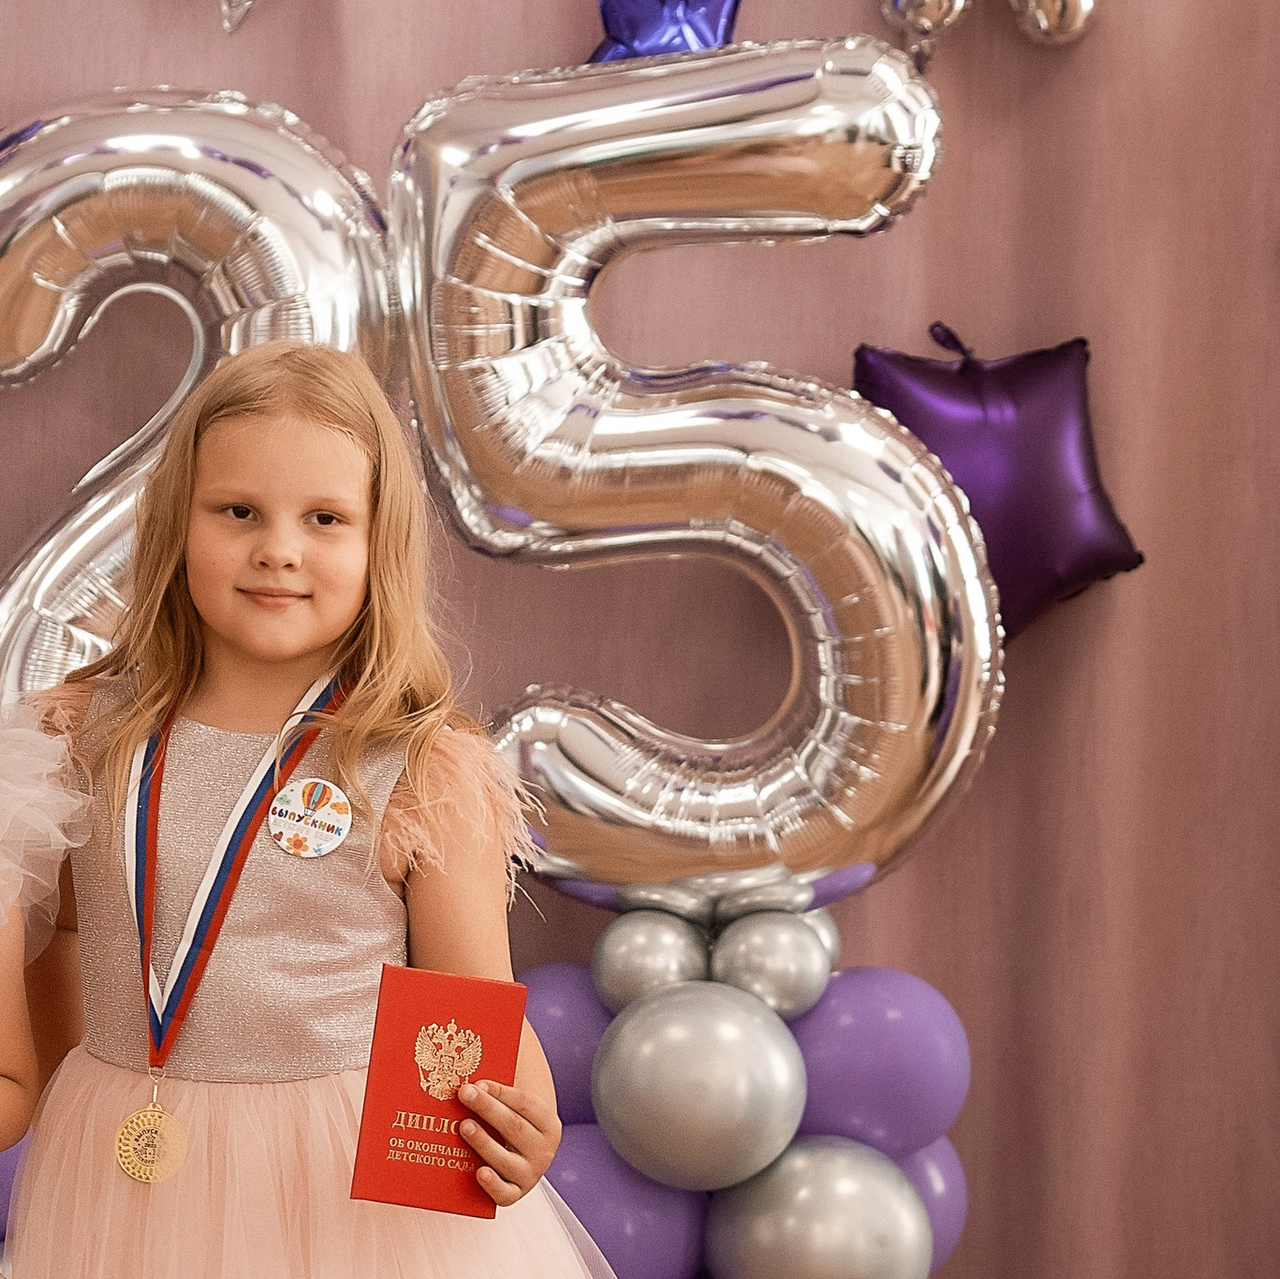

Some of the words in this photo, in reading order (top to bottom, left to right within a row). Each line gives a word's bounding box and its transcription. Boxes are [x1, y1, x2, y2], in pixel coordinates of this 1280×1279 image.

[392, 1110, 460, 1135] ДИПЛО
[386, 1149, 446, 1167] ДЕТСКОГО
[389, 1137, 405, 1148] ОБ
[406, 1140, 471, 1158] ОКОНЧАНИ
